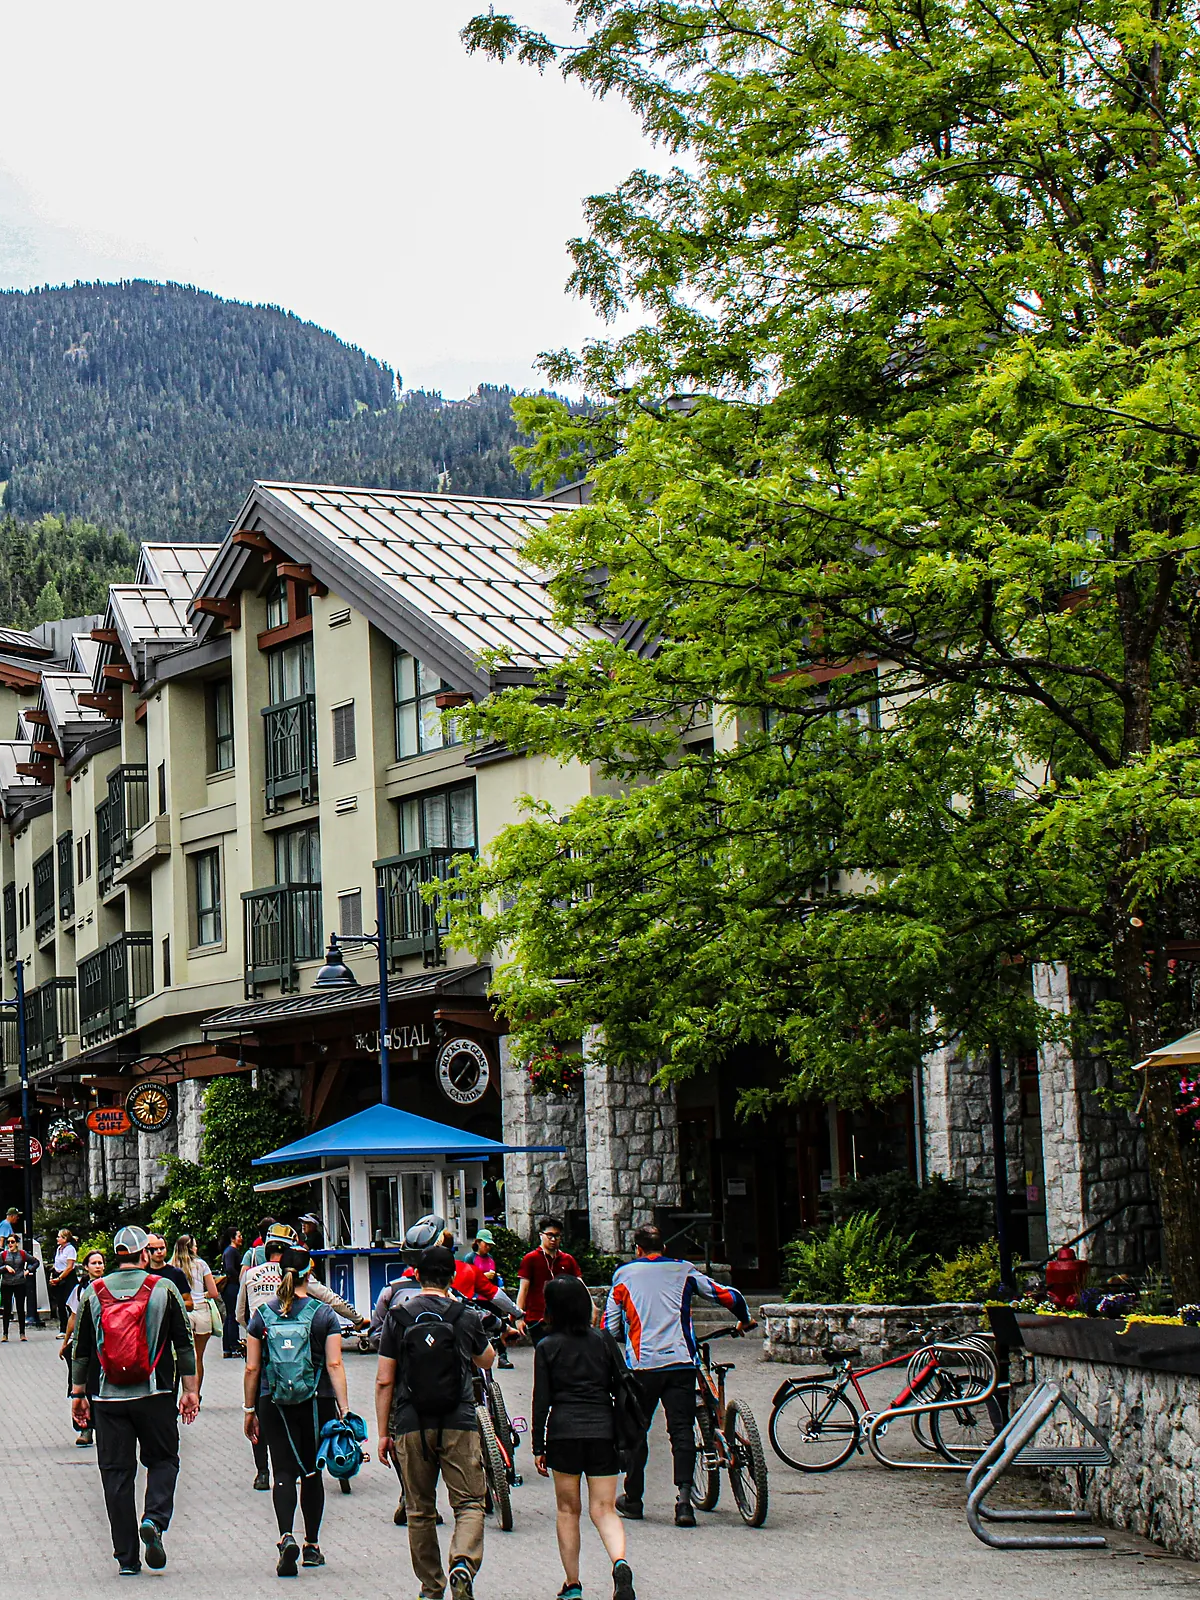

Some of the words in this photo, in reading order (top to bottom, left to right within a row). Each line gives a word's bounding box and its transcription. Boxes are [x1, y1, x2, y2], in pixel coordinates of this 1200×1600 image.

[441, 1041, 460, 1067] ROCKS
[461, 1041, 470, 1050] &
[470, 1044, 487, 1068] GEMS
[449, 1088, 481, 1102] CANADA
[95, 1111, 124, 1121] SMILE
[97, 1121, 122, 1131] GIFT
[252, 1265, 276, 1282] FASTH
[253, 1284, 275, 1293] SPEED
